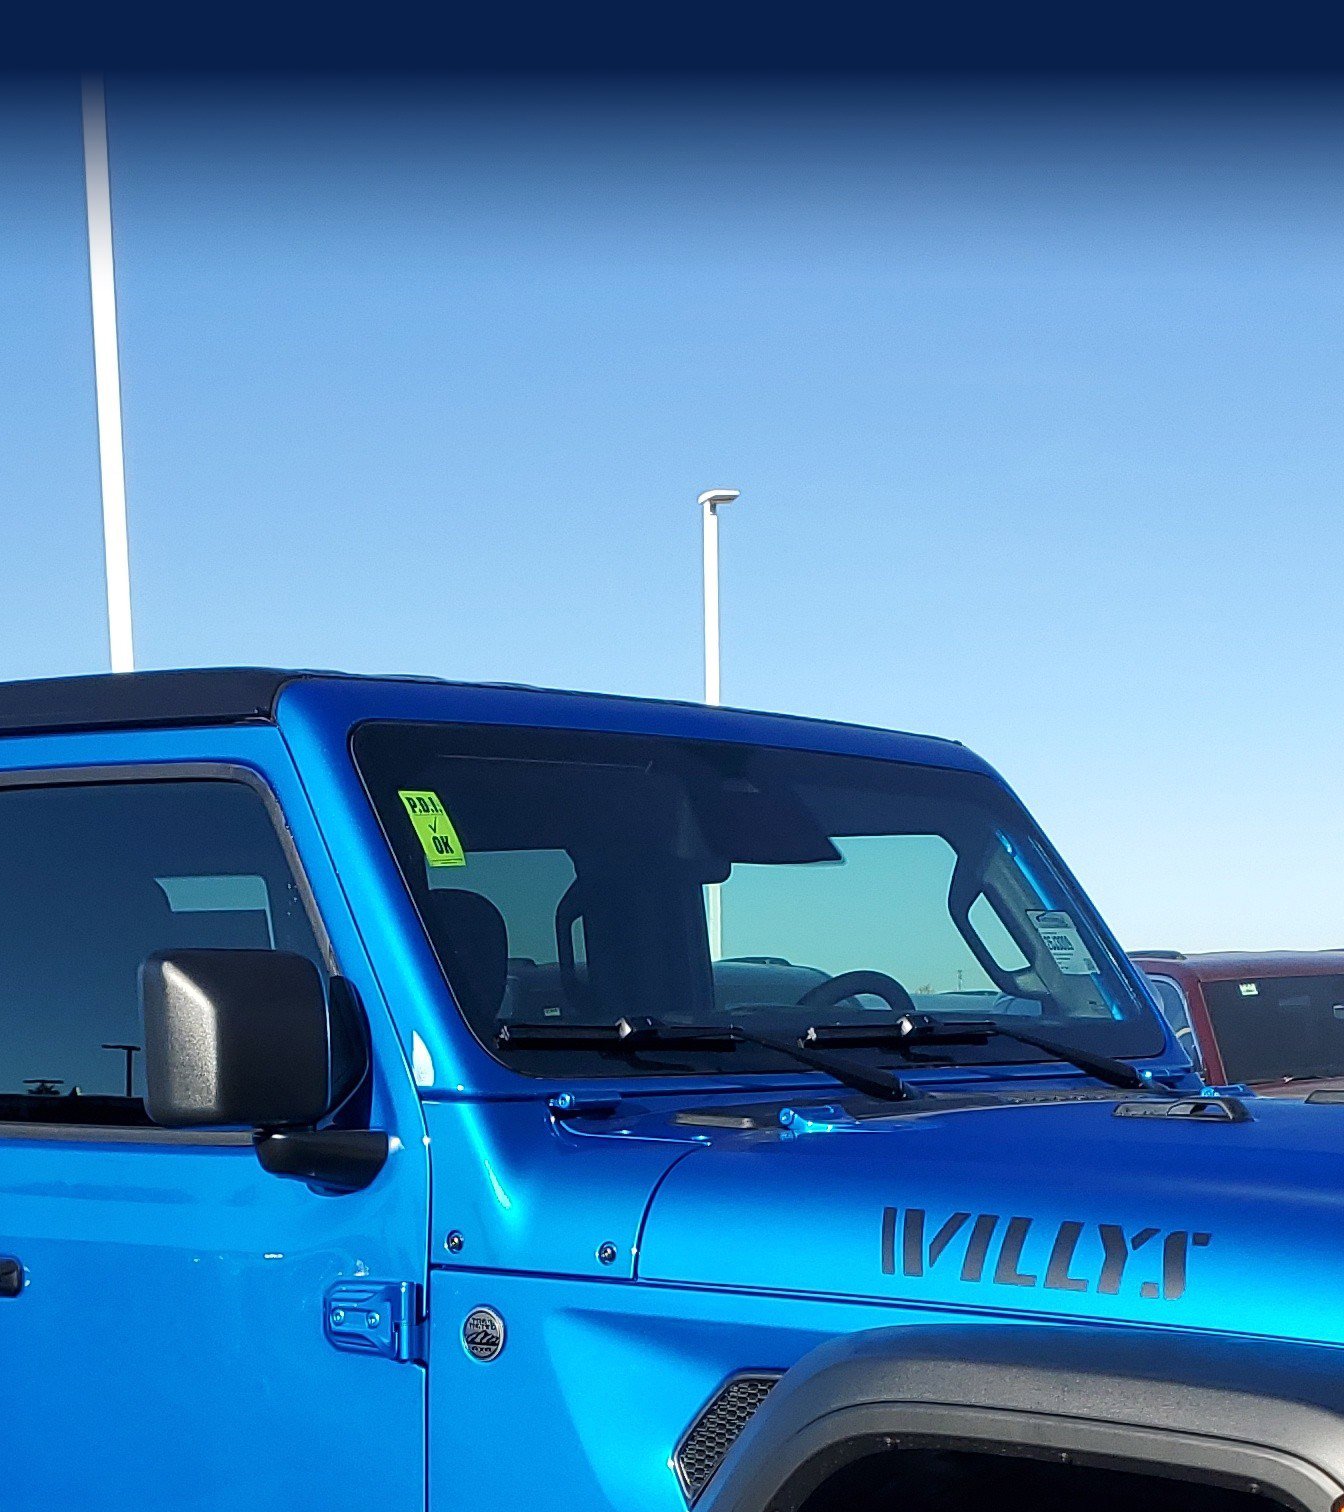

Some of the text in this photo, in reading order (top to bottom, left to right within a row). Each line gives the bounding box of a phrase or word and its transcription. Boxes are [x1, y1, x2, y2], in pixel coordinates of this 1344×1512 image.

[404, 796, 443, 814] P.D.I.
[431, 835, 454, 854] OK
[881, 1206, 1212, 1300] WILLYS
